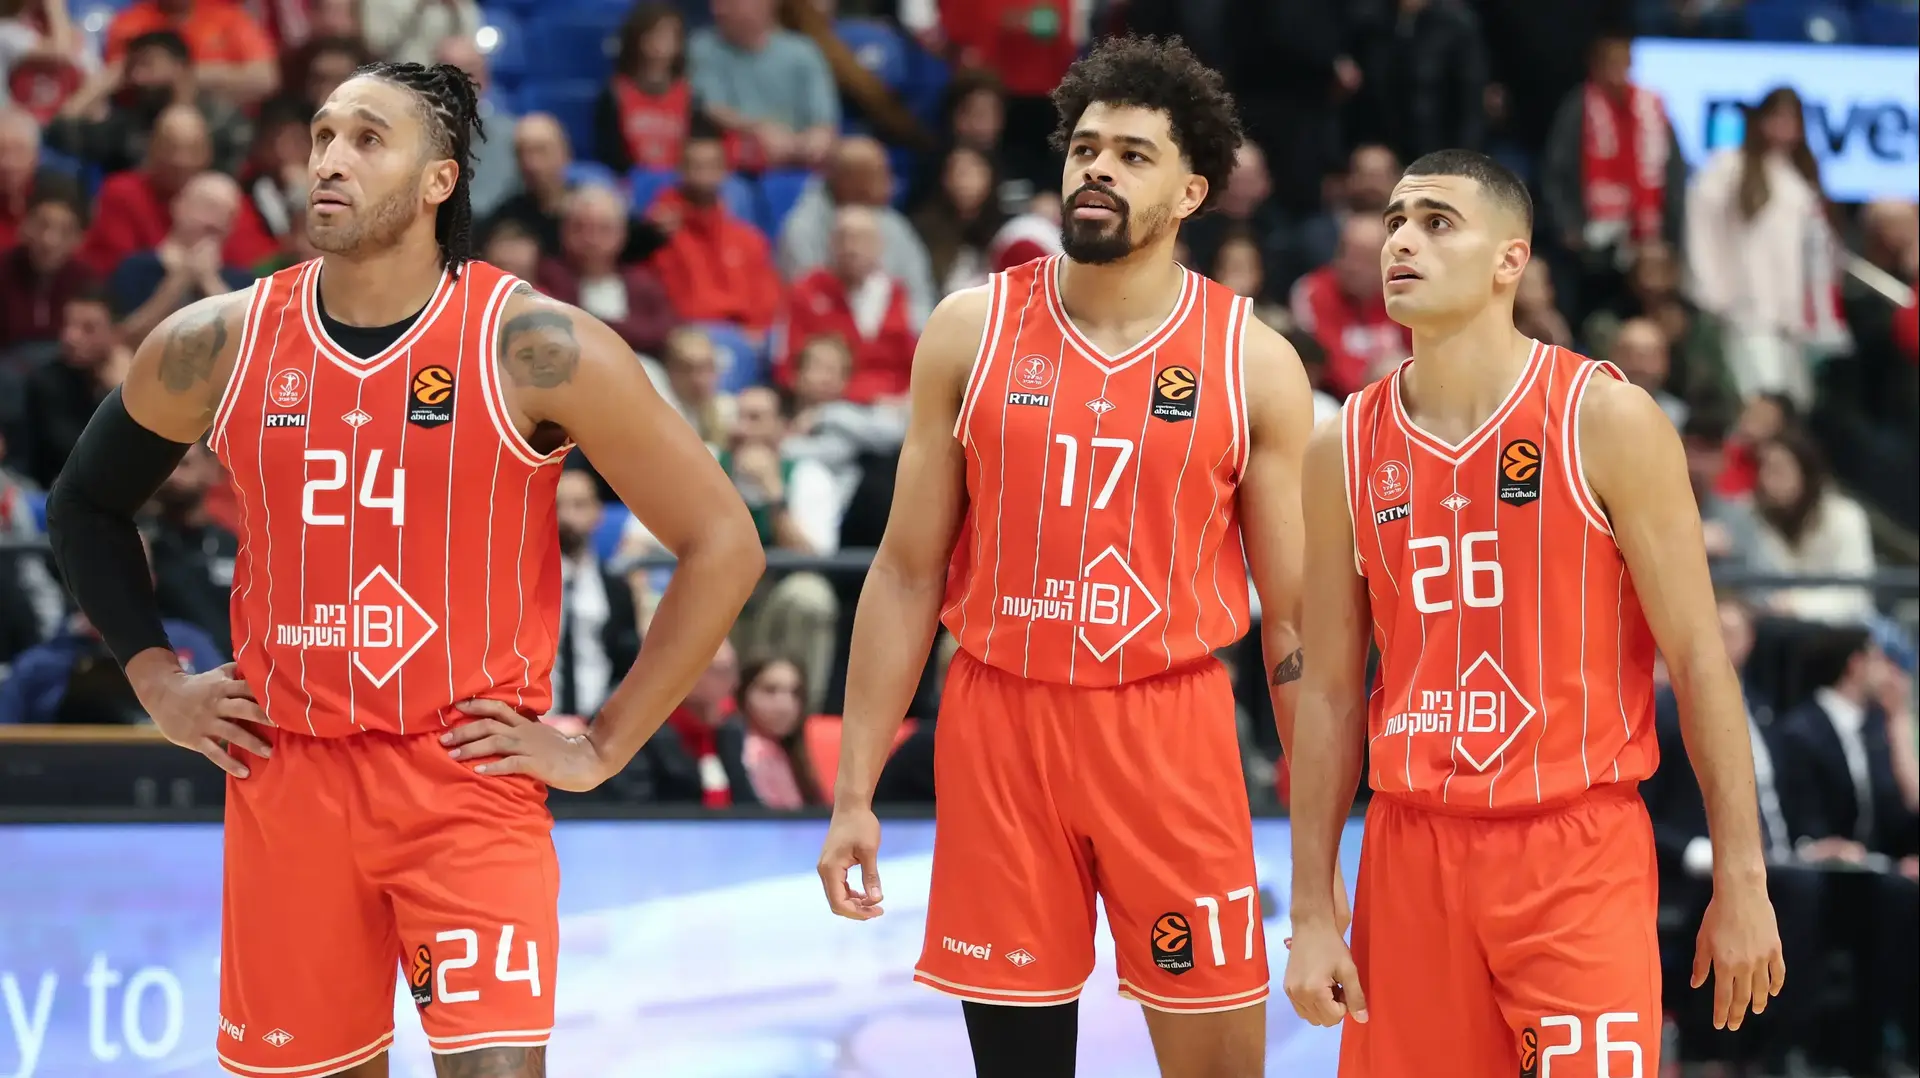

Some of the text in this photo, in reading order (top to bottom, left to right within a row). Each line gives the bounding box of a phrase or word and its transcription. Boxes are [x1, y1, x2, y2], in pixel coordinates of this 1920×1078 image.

[1009, 393, 1049, 406] RTMI
[266, 414, 306, 427] RTMI
[426, 413, 450, 421] dhabi
[1169, 409, 1192, 417] dhabi
[1056, 433, 1134, 510] 17
[302, 449, 405, 525] 24
[1515, 490, 1537, 498] dhabi
[1408, 530, 1504, 614] 26
[1044, 578, 1075, 599] בית
[314, 604, 347, 625] בית
[1001, 595, 1074, 621] השקעות
[1080, 581, 1131, 626] IBI
[276, 624, 346, 650] השקעות
[353, 604, 403, 648] IBI
[1420, 690, 1453, 711] בית
[1458, 690, 1506, 733] IBI
[1384, 712, 1452, 737] השקעות
[1194, 885, 1255, 967] 17
[942, 936, 992, 961] nuvei
[436, 925, 541, 1004] 24
[83, 951, 184, 1062] to
[218, 1012, 246, 1042] uvei
[1540, 1012, 1643, 1078] 26
